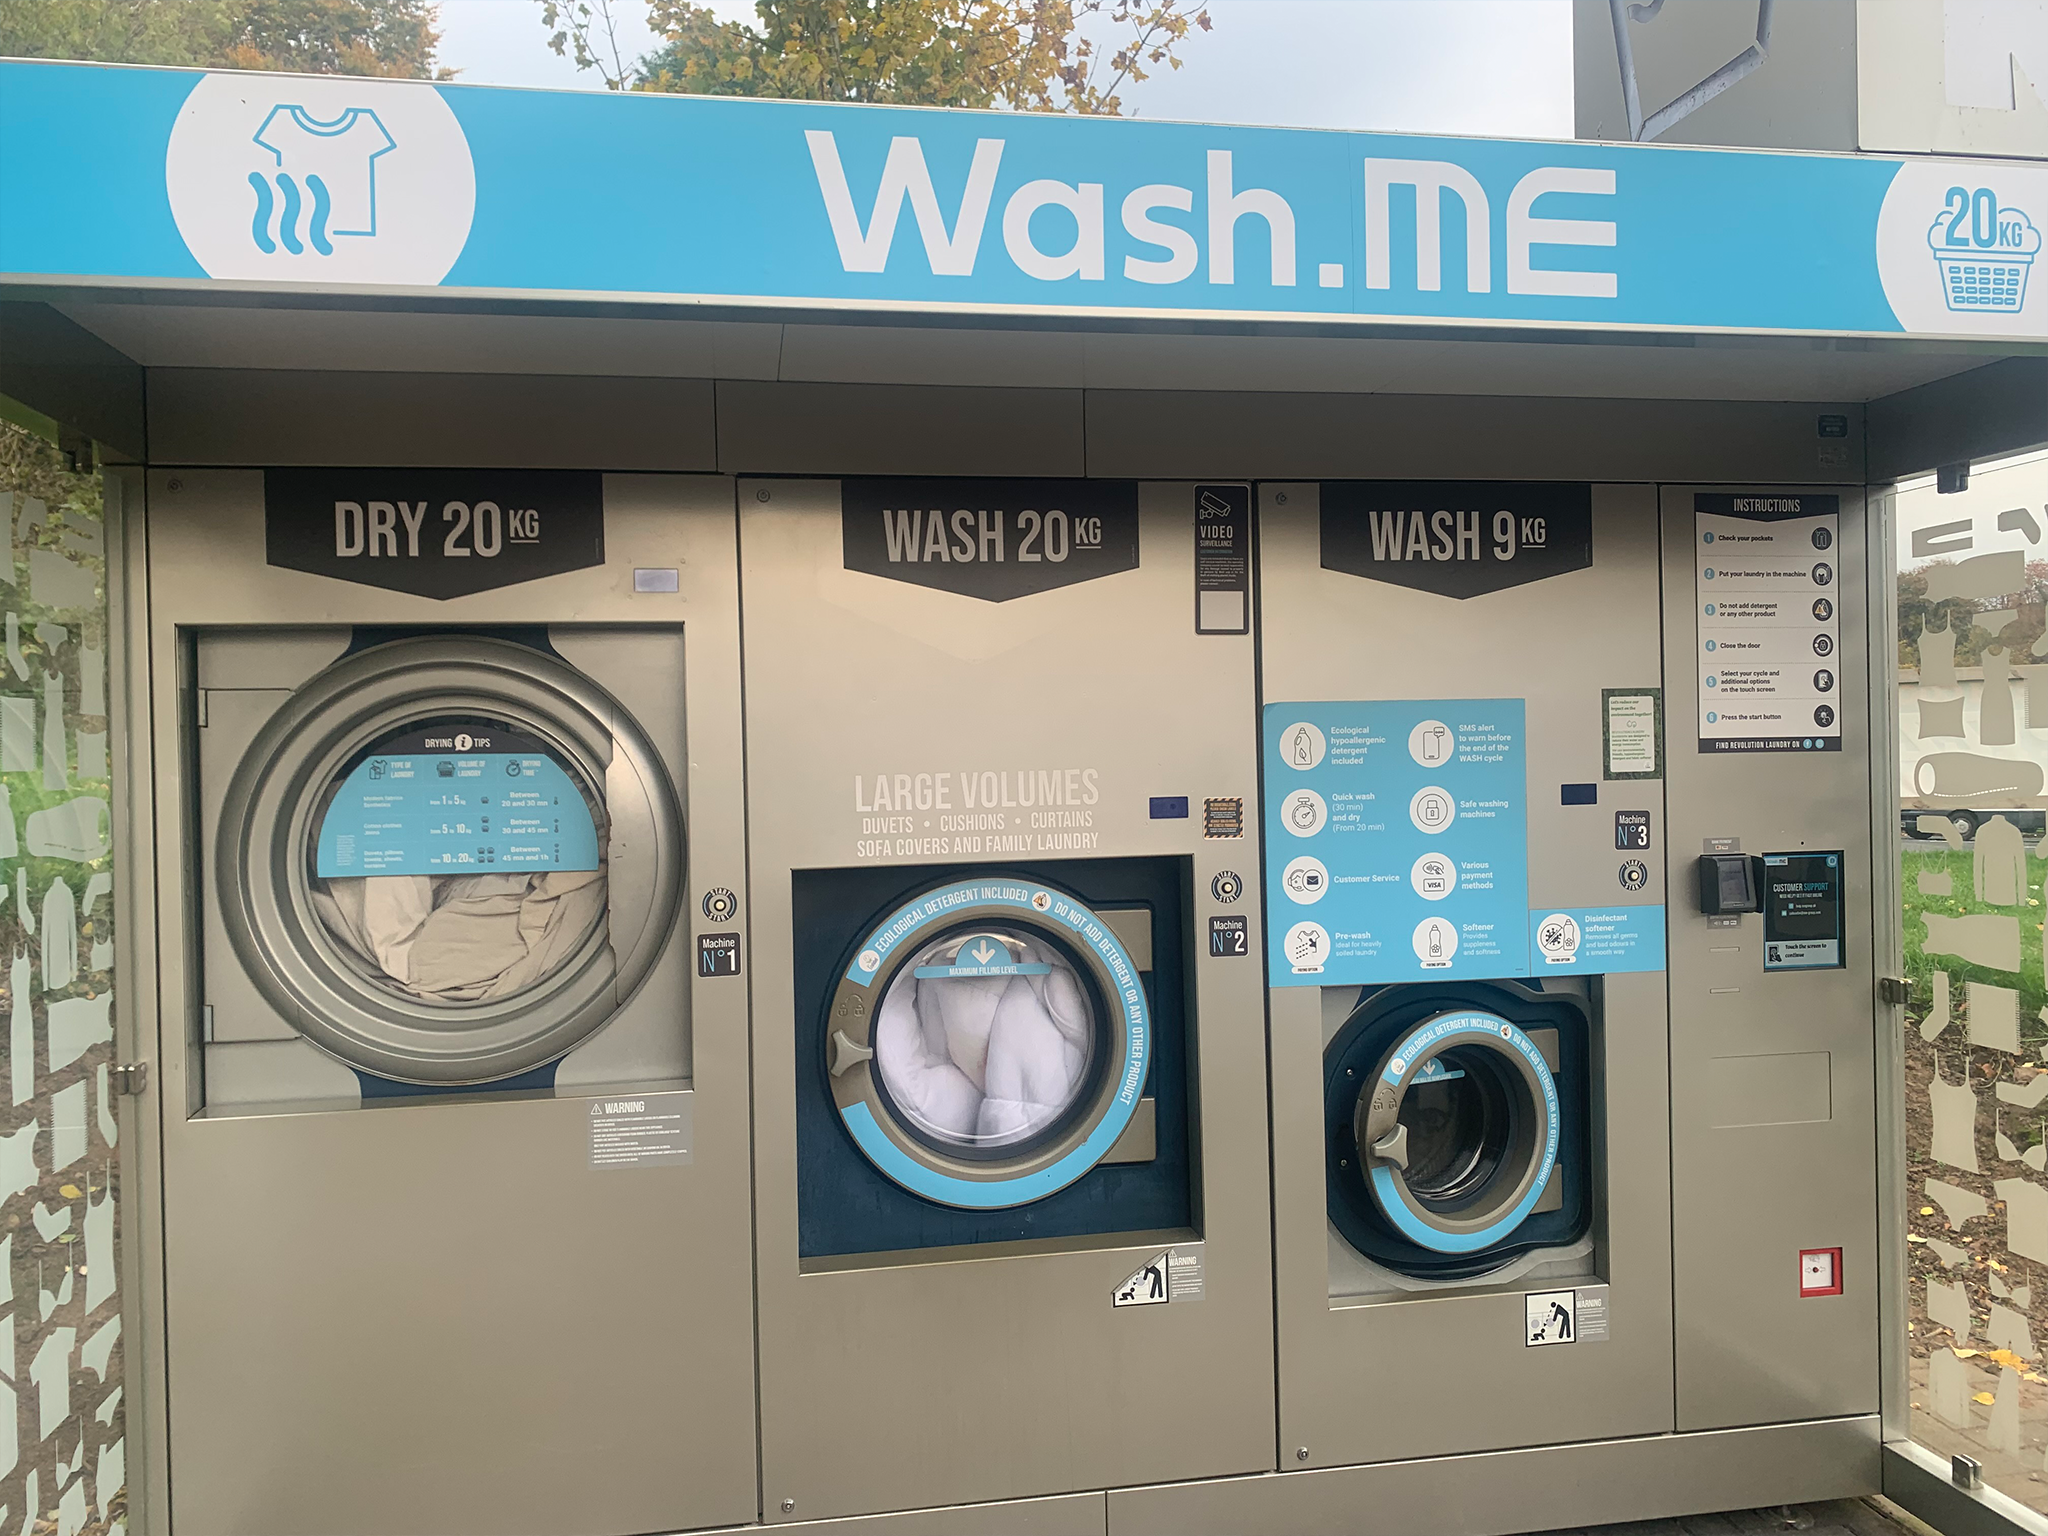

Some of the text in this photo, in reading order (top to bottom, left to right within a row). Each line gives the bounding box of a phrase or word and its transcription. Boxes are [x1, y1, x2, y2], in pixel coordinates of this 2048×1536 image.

[803, 129, 1618, 298] Wash.ME
[1733, 498, 1800, 512] INSTRUCTIONS
[335, 501, 540, 557] DRY 20 KG
[1200, 526, 1233, 538] VIDEO
[883, 509, 1102, 563] WASH 20 KG
[1368, 510, 1546, 561] WASH 9 KG
[1331, 726, 1369, 735] Ecological
[425, 738, 490, 748] DRYING TIPS
[1331, 736, 1386, 745] hypoallergenic
[1331, 747, 1367, 755] detergent
[1484, 754, 1503, 763] cycle
[855, 768, 1099, 812] LARGE VOLUMES
[1332, 793, 1353, 801] Quick
[1332, 803, 1363, 812] (30 min)
[1478, 800, 1508, 808] washing
[863, 811, 1093, 834] DUVETS CUSHIONS CURTAINS
[1348, 814, 1360, 822] dry
[1619, 815, 1645, 824] Machine
[1333, 824, 1355, 833] (From
[1368, 823, 1385, 831] min)
[857, 832, 1099, 857] SOFA COVERS AND FAMILY LAUNDRY
[1217, 871, 1235, 879] START
[1462, 872, 1493, 881] payment
[710, 888, 731, 896] START
[1773, 883, 1828, 892] CUSTOMER SUPPORT
[1219, 894, 1237, 903] START
[709, 913, 730, 921] START
[874, 886, 1028, 953] ECOLOGICAL DETERGENT INCLUDED
[1585, 914, 1627, 922] Disinfectant
[1214, 920, 1242, 930] Machine
[1585, 924, 1615, 932] softener
[702, 938, 735, 948] Machine
[949, 965, 1018, 975] MAXIMUM FILLING LEVEL
[1054, 902, 1143, 1106] DO NOT ADD DETERGENT OR ANY OTHER PRODUCT
[1402, 1018, 1498, 1061] ECOLOGICAL DETERGENT INCLUDED
[605, 1101, 645, 1114] WARNING
[1169, 1256, 1197, 1266] WARNING
[1576, 1299, 1601, 1308] WARNING
